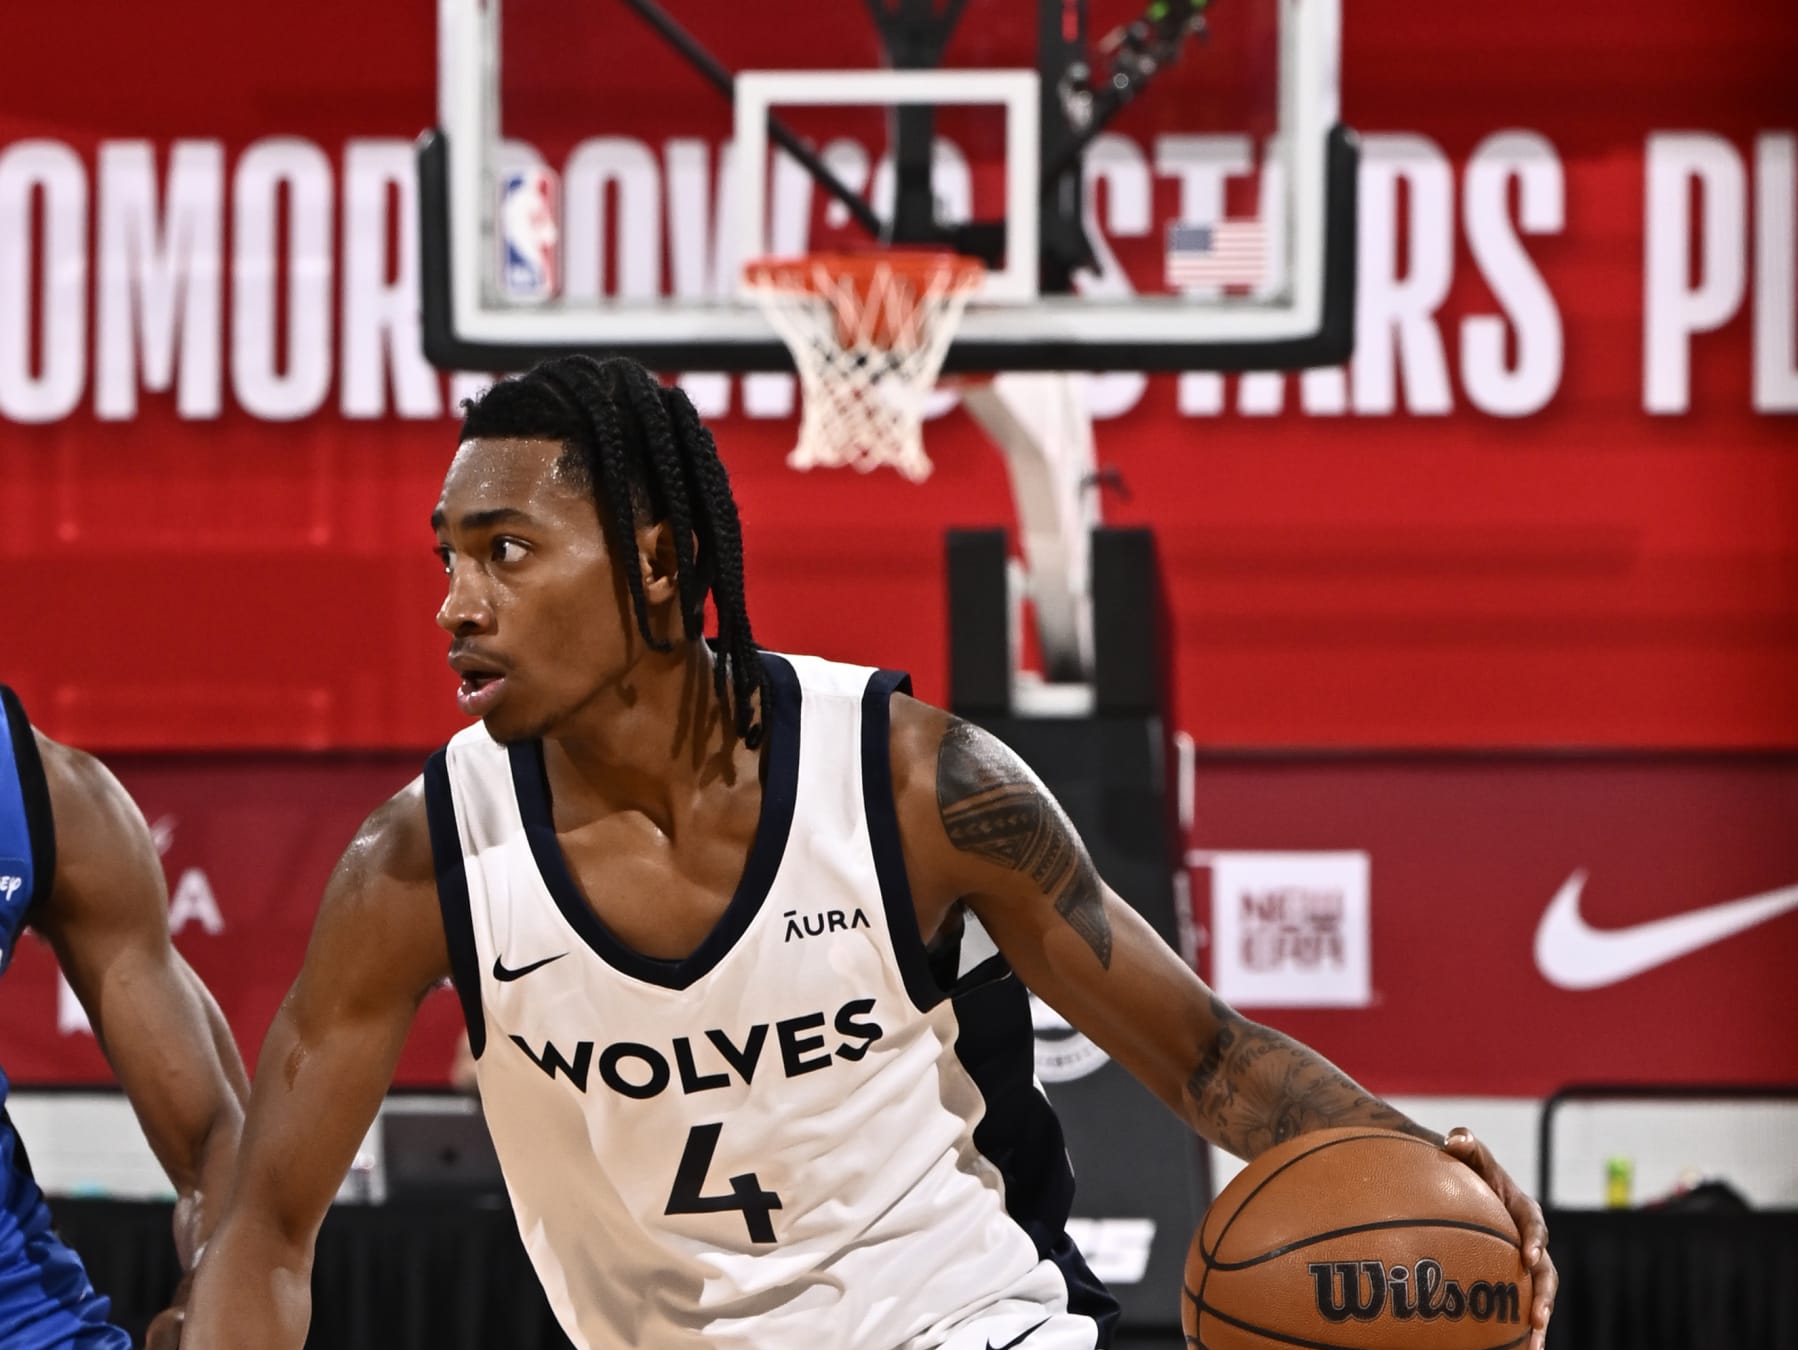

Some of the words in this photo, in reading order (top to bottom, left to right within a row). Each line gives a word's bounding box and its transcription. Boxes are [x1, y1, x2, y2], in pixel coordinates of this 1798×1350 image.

[510, 998, 884, 1100] WOLVES
[664, 1122, 783, 1244] 4
[1307, 1257, 1521, 1325] Wilson
